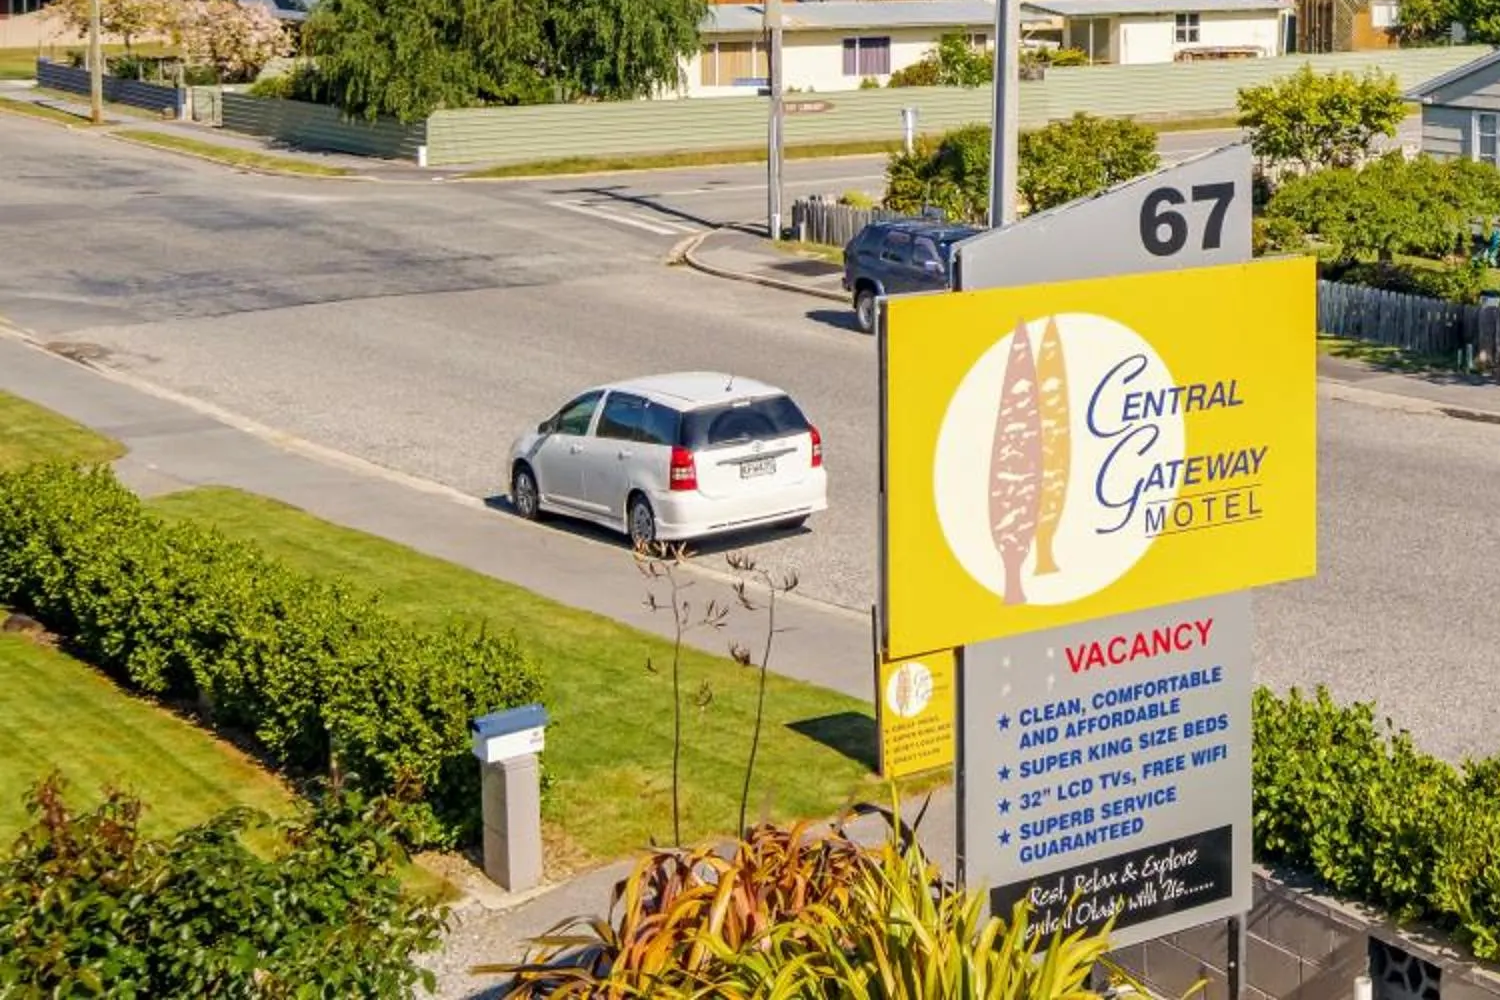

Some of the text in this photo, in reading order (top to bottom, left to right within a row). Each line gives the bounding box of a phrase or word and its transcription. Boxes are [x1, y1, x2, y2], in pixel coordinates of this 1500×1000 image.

[1139, 182, 1236, 257] 67
[1087, 354, 1245, 438] CENTRAL
[1095, 424, 1269, 534] GATEWAY
[1145, 490, 1263, 534] MOTEL
[1065, 618, 1214, 673] VACANCY
[1019, 666, 1222, 727] CLEAN, COMFORTABLE
[1019, 697, 1181, 749] AND AFFORDABLE
[1019, 713, 1228, 778] SUPER KING SIZE BEDS
[1019, 744, 1228, 810] 32" LCD TVs, FREE WIFI
[1019, 786, 1177, 840] SUPERB SERVICE
[1019, 817, 1144, 863] GUARANTEED
[1075, 867, 1117, 894] Relax
[1121, 861, 1139, 883] &
[1141, 846, 1198, 884] Explore
[1128, 881, 1157, 910] with
